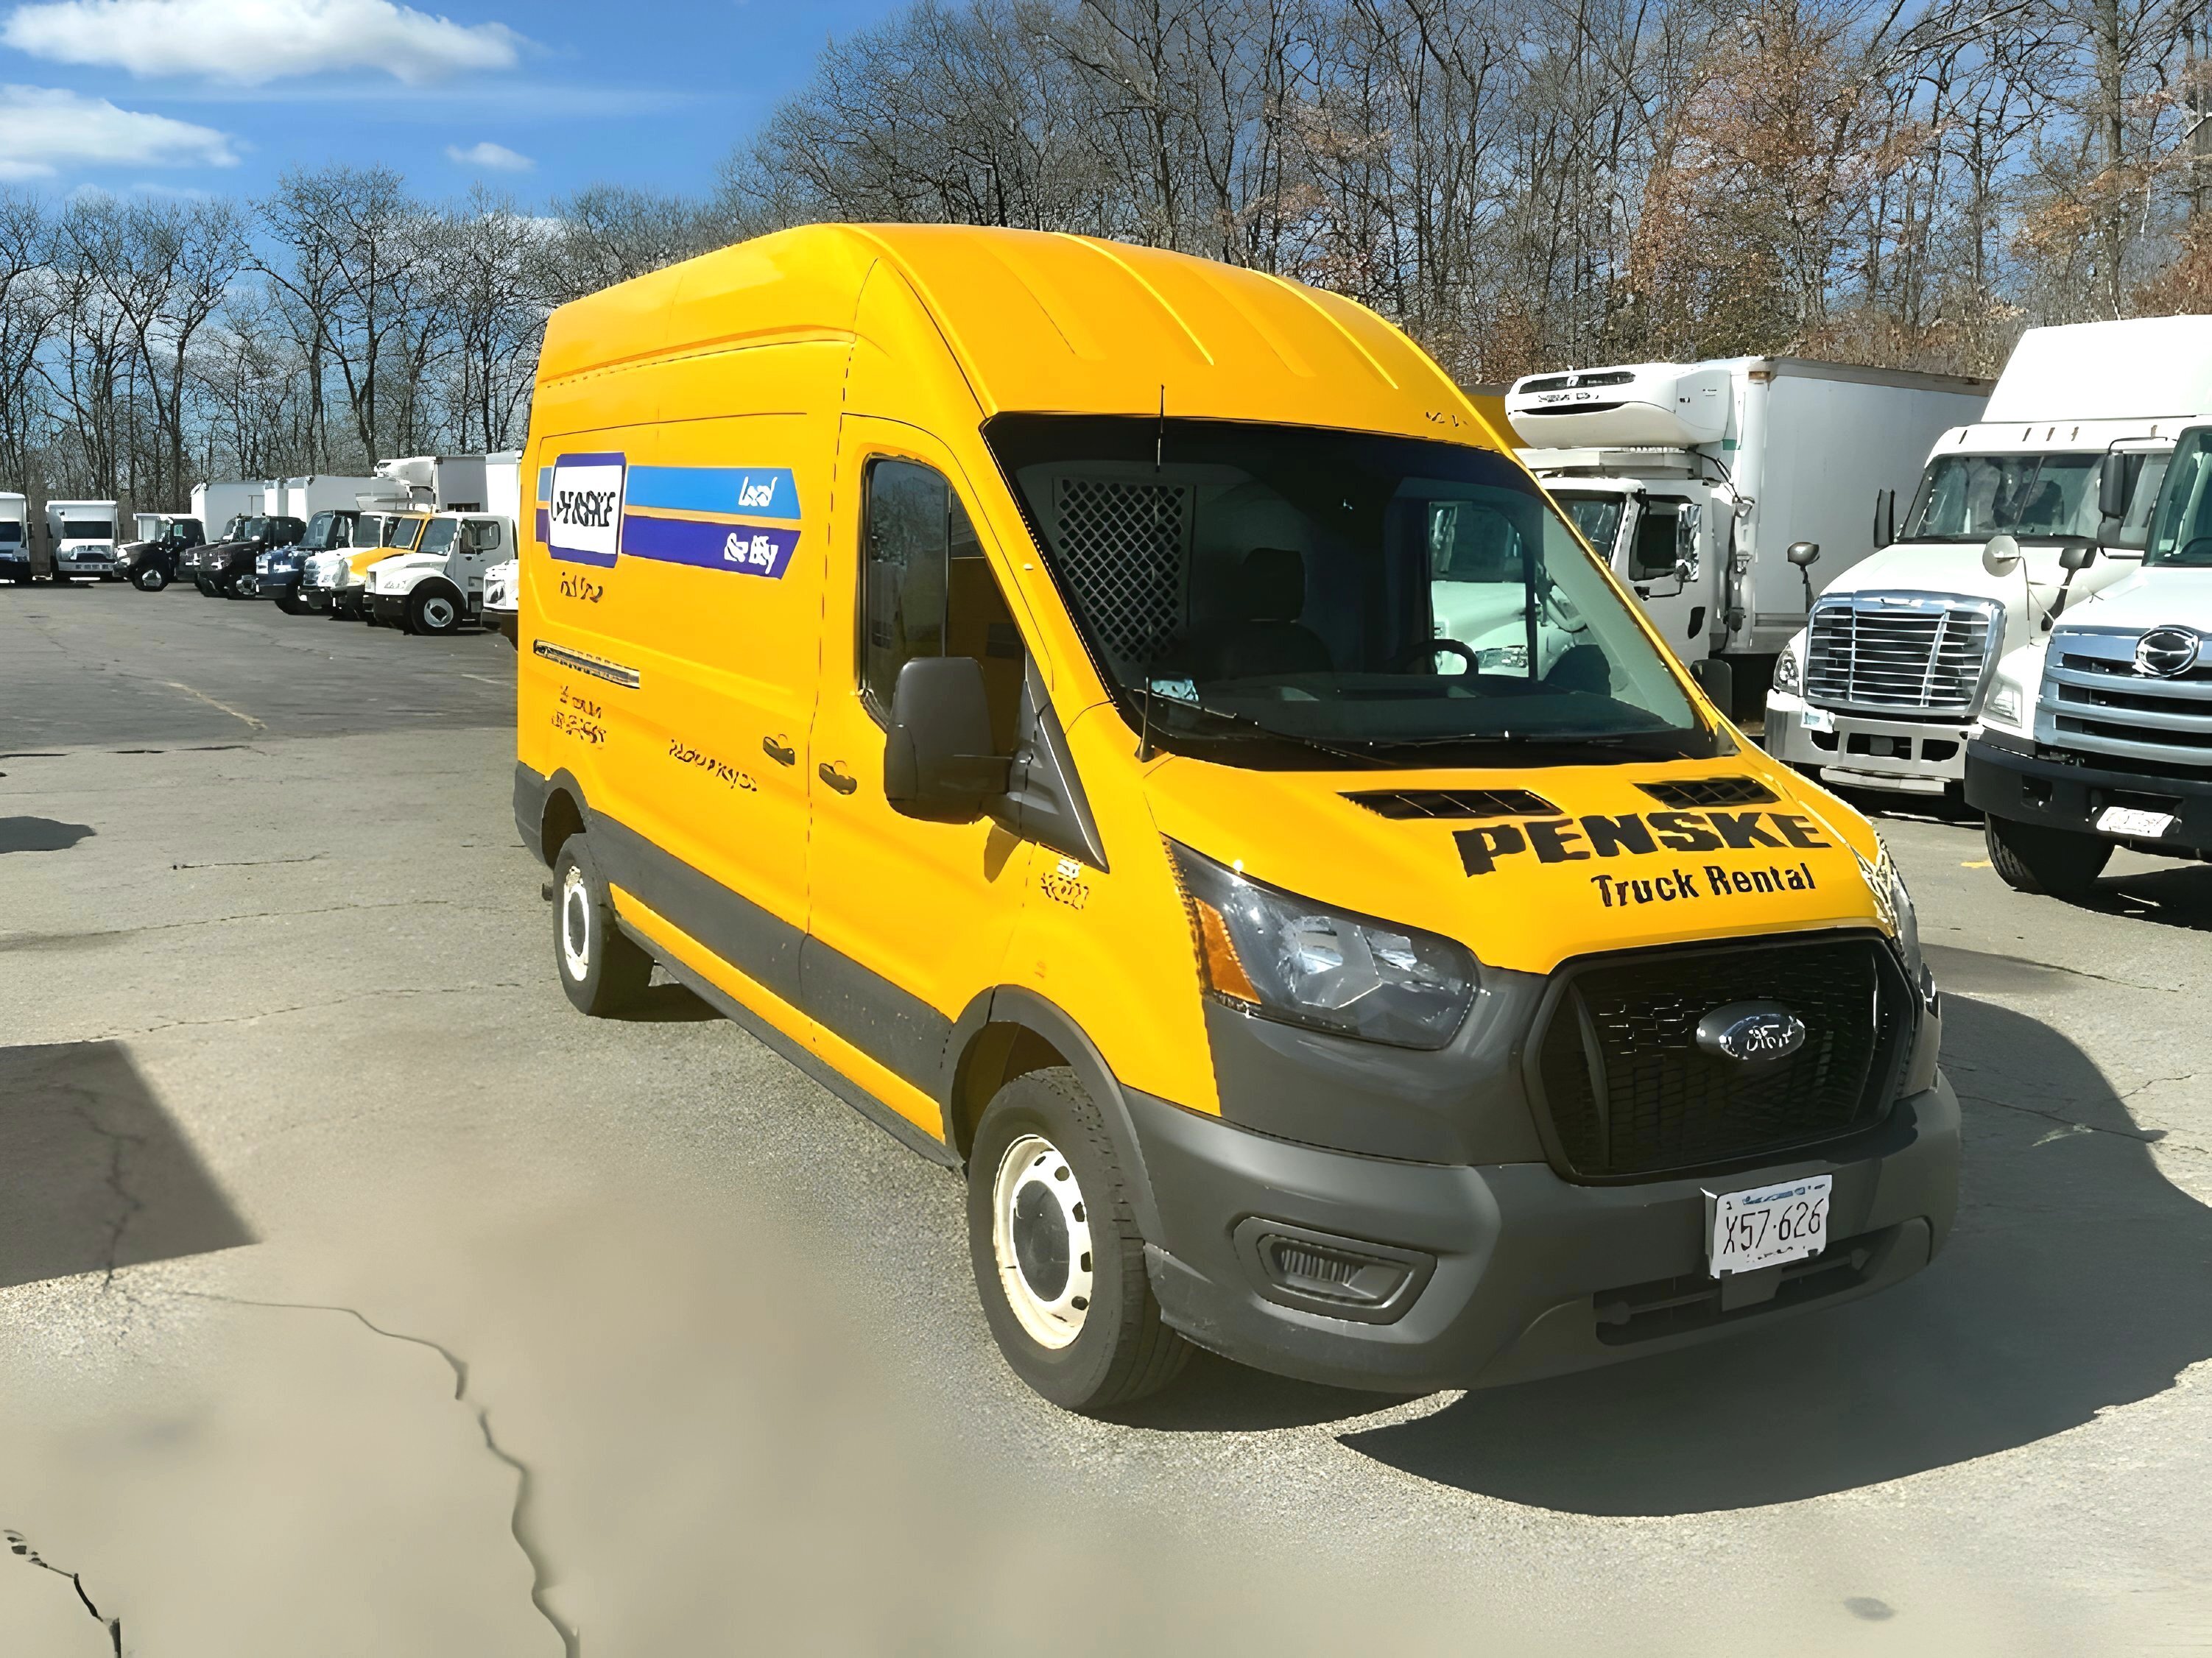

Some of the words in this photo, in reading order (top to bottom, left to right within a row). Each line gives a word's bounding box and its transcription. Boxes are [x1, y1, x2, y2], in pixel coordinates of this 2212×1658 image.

[1451, 812, 1832, 878] PENSKE
[1591, 869, 1699, 908] Truck
[1702, 863, 1816, 896] Rental
